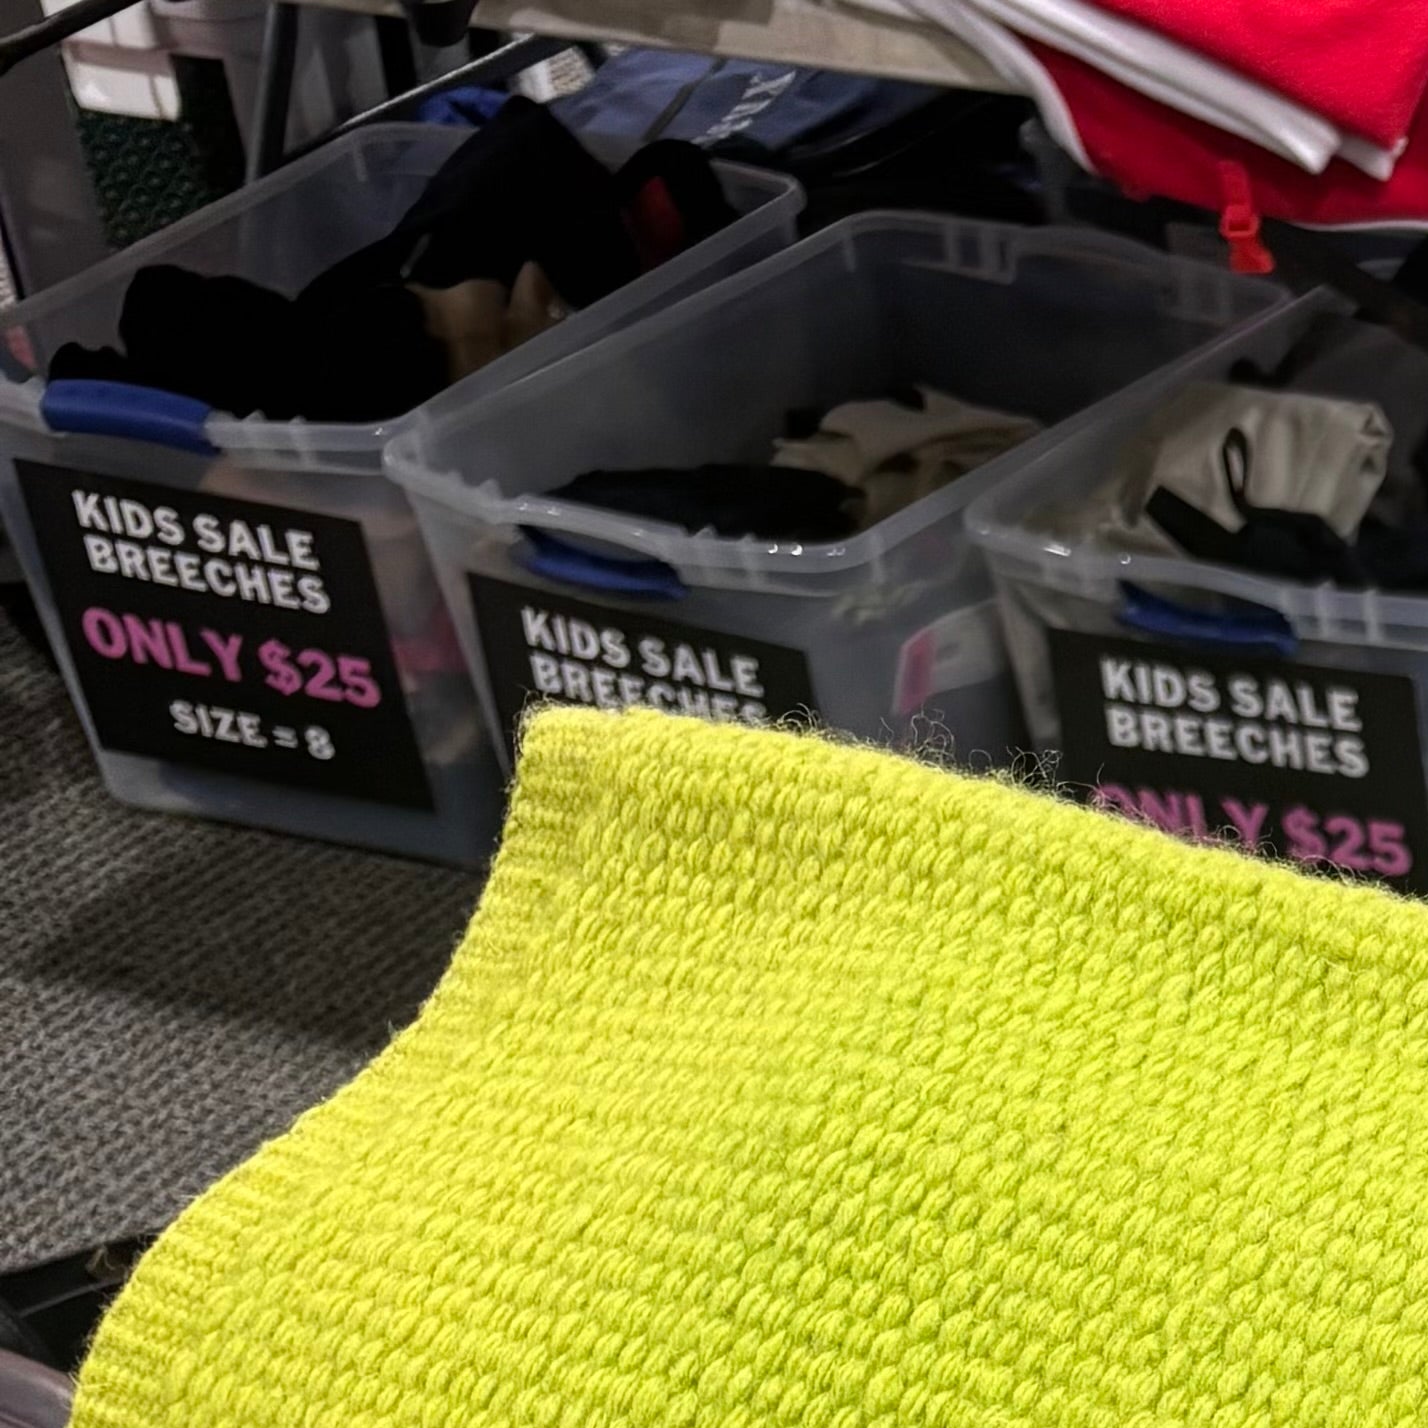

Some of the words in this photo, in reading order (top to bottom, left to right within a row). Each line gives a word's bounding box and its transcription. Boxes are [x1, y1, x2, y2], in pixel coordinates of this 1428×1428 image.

[72, 489, 186, 545] KIDS
[193, 513, 321, 572] SALE
[83, 533, 331, 615] BREECHES
[82, 606, 243, 683] ONLY
[257, 638, 382, 708] $25
[521, 605, 631, 669] KIDS
[638, 635, 766, 698] SALE
[169, 699, 268, 749] SIZE
[304, 725, 336, 761] 8
[1101, 657, 1221, 713] KIDS
[1228, 674, 1363, 733] SALE
[1105, 702, 1370, 779] BREECHES
[1280, 803, 1412, 876] $25
